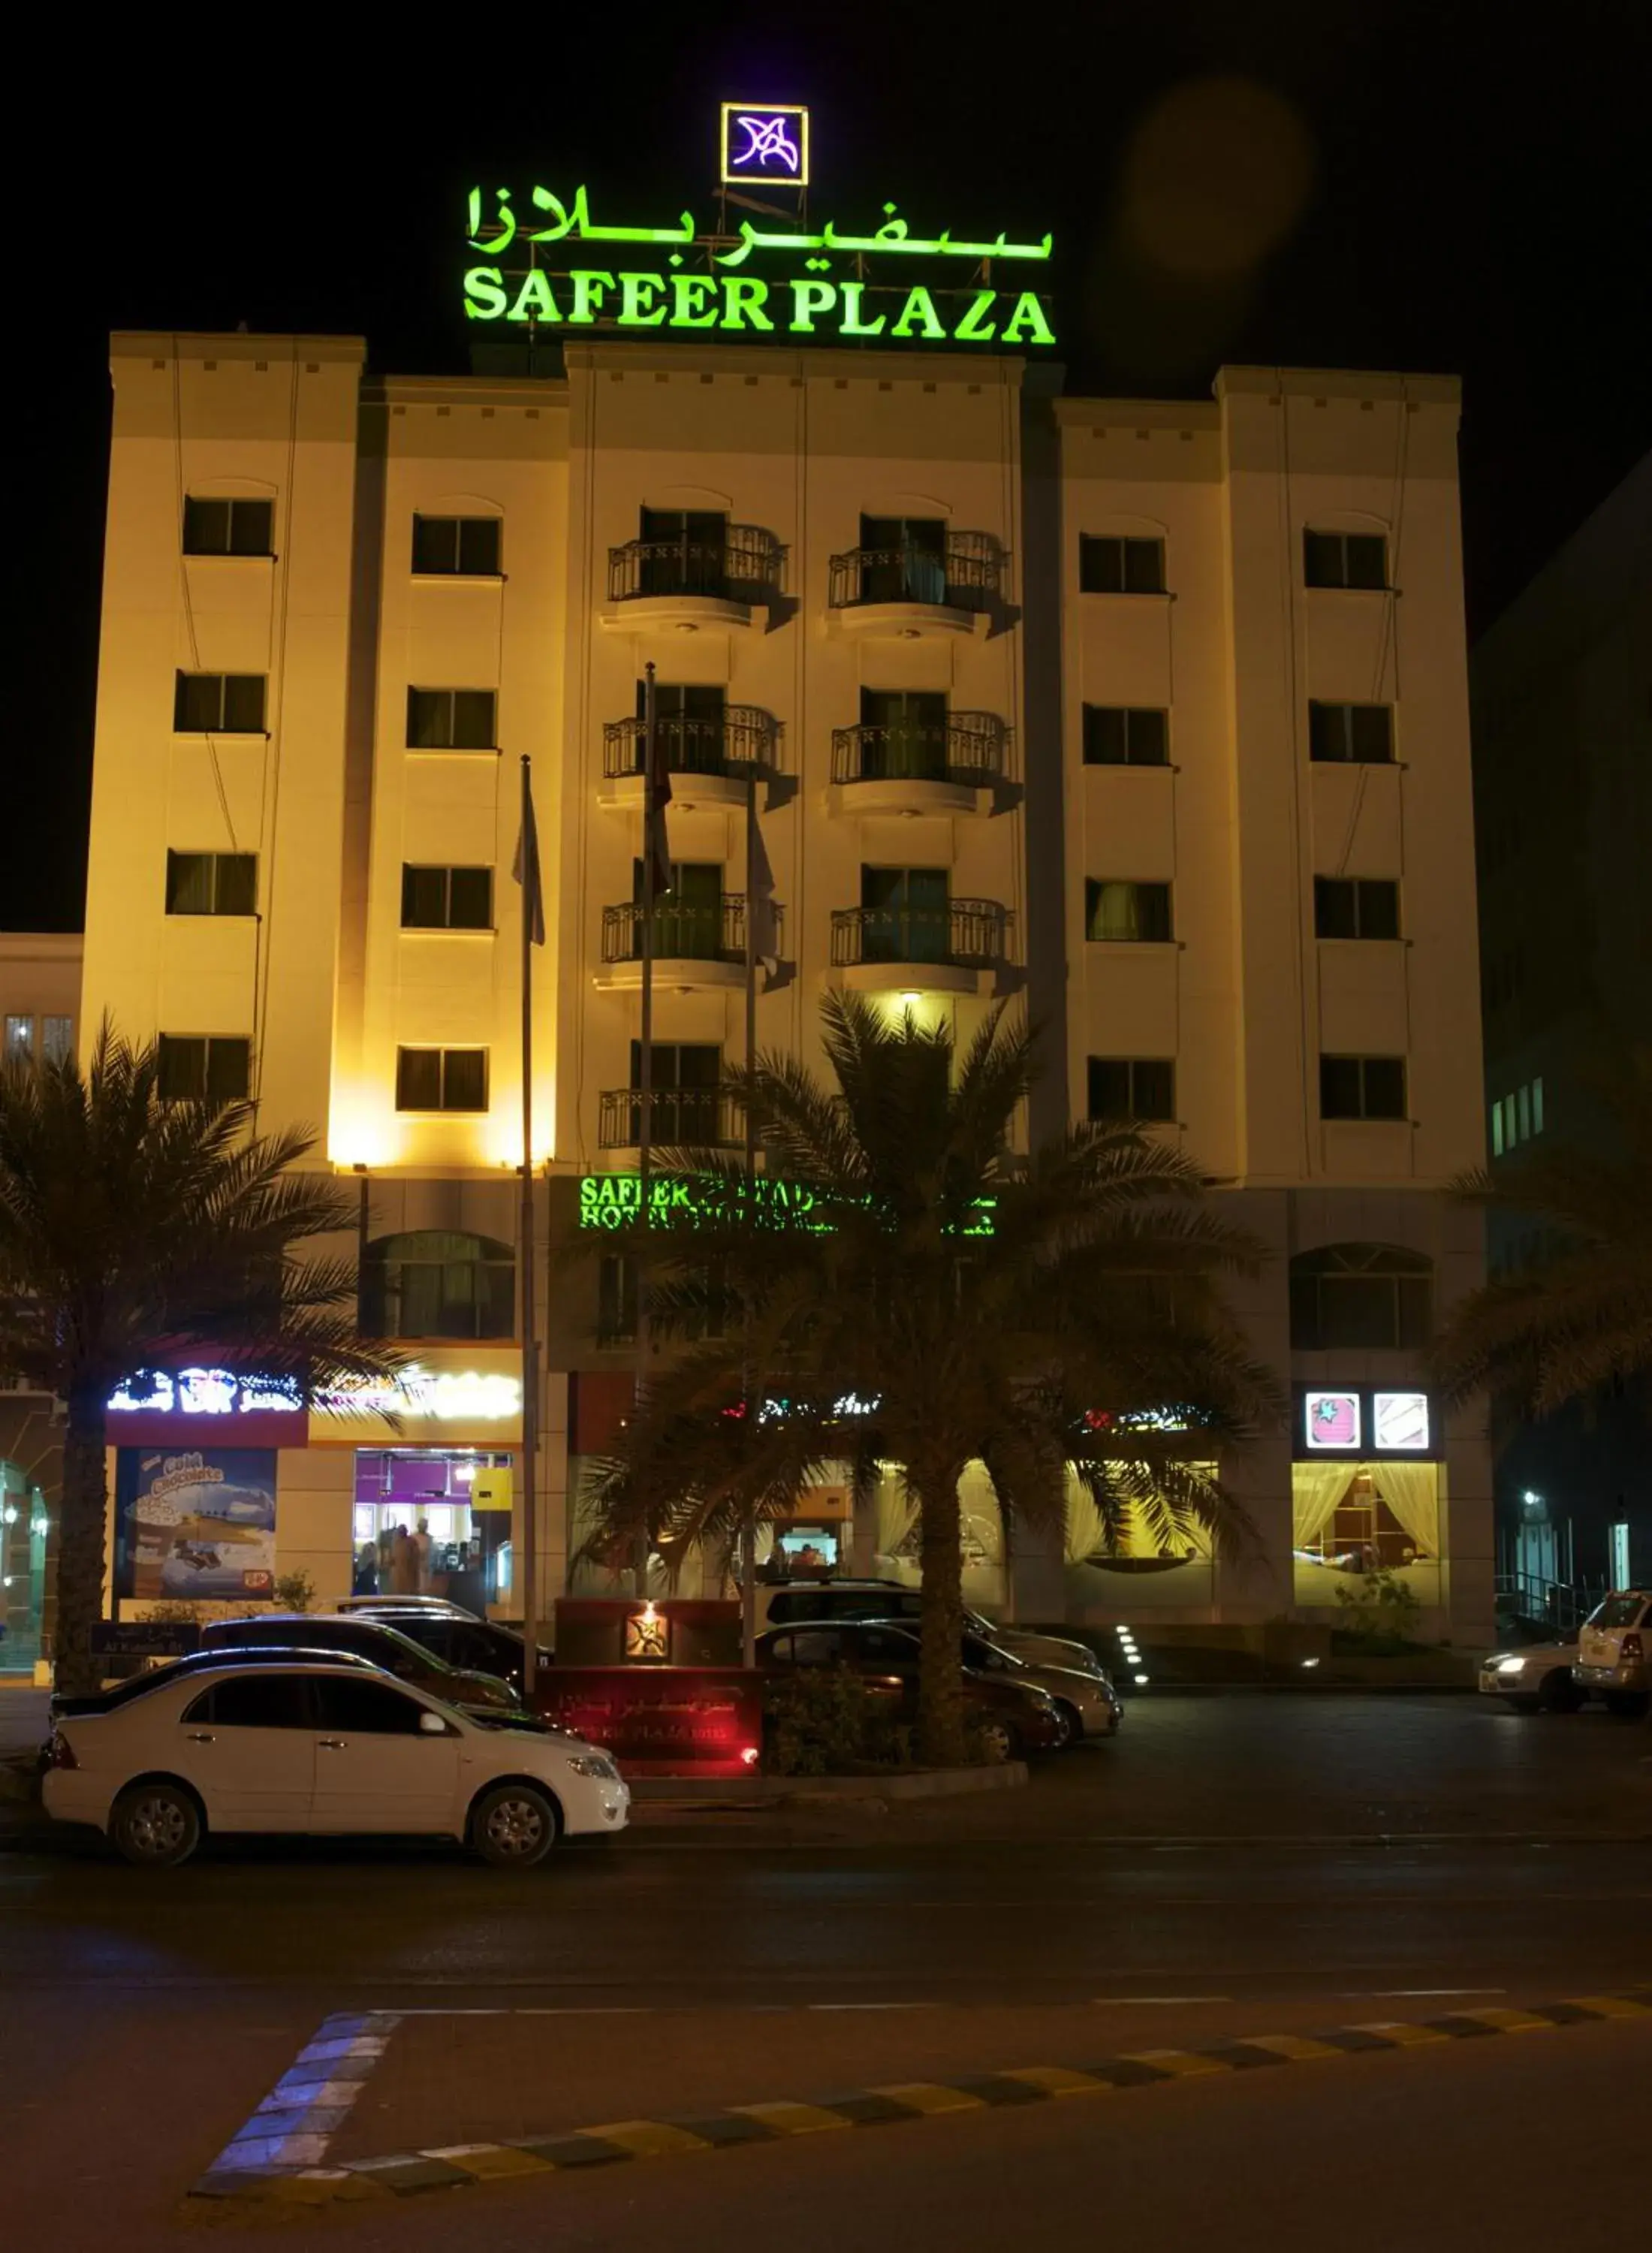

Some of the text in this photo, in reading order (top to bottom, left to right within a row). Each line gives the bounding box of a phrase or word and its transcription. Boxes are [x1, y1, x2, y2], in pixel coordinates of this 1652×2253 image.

[467, 183, 1054, 271] سفير بلازا
[463, 267, 1057, 345] SAFEER PLAZA
